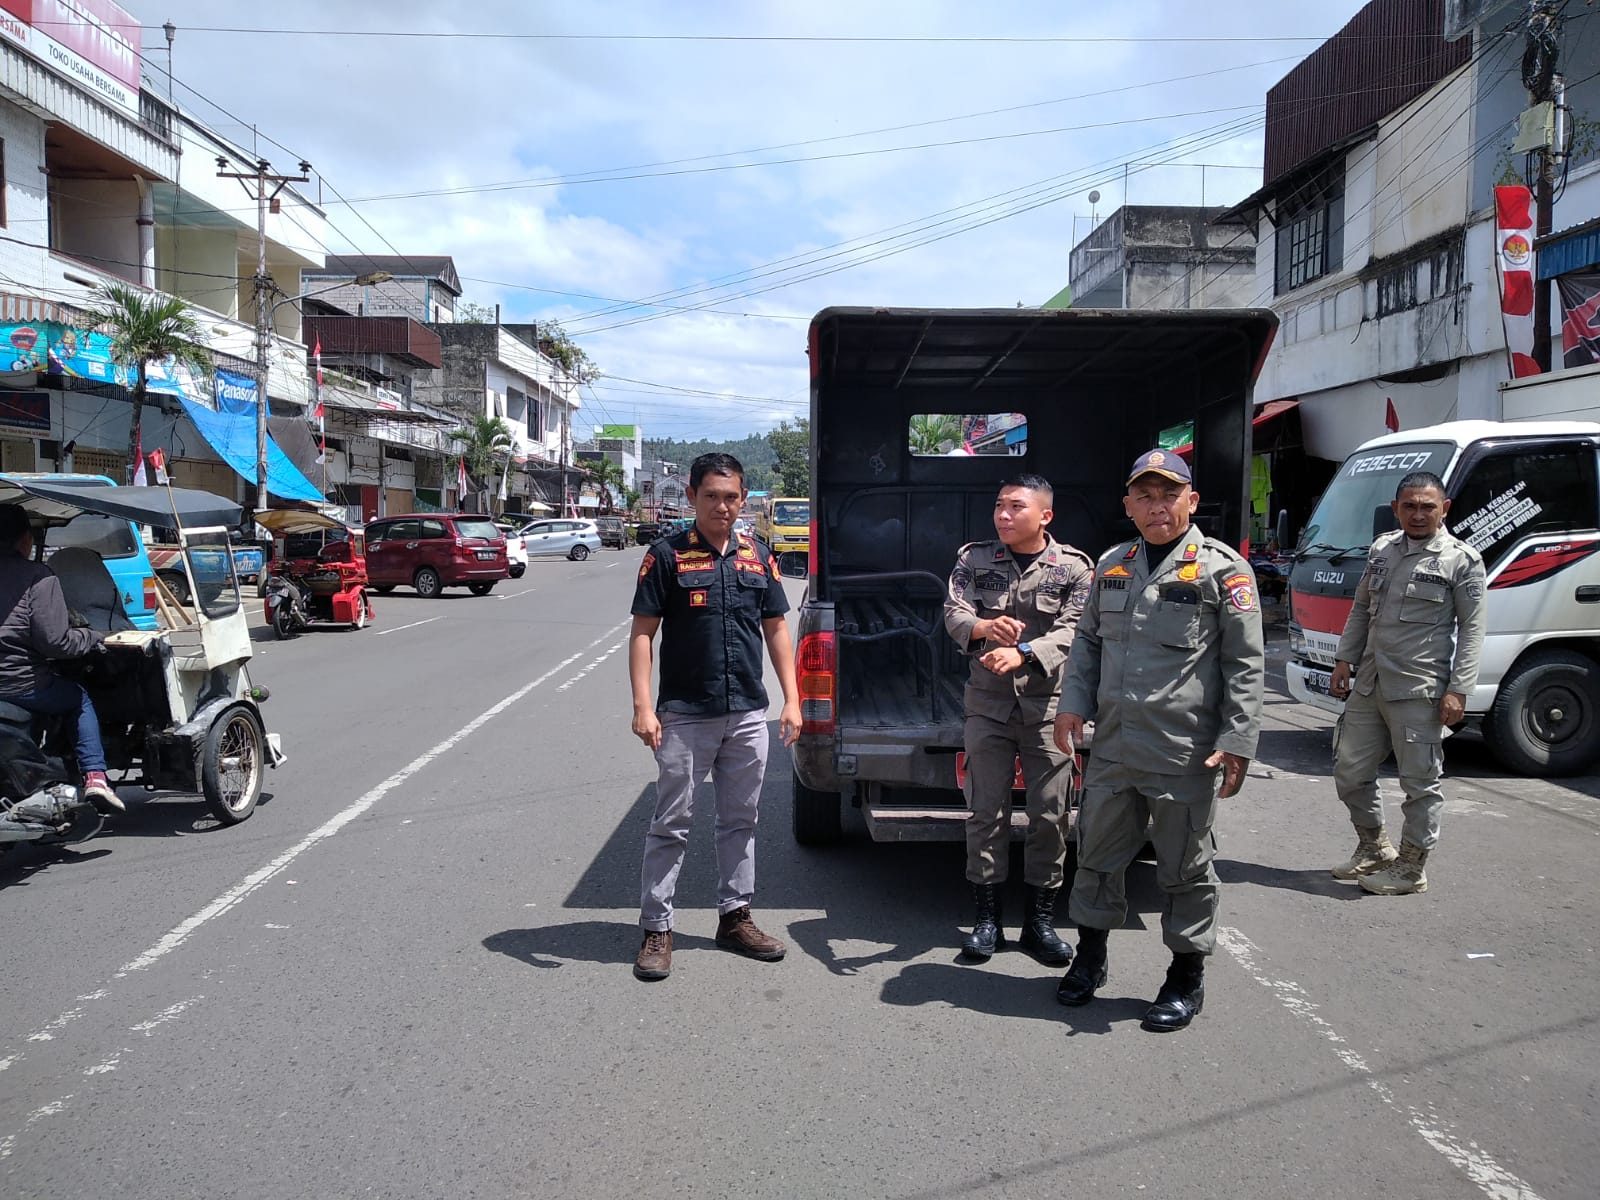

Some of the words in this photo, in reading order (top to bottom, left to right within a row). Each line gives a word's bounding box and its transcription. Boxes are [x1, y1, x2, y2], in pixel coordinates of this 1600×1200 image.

[42, 0, 134, 66] OLYTRON
[48, 44, 69, 66] TOKO
[70, 59, 95, 83] USAHA
[95, 75, 126, 104] BERSAMA
[1347, 451, 1433, 477] REBECCA
[1452, 507, 1489, 535] BEKERJA
[1486, 480, 1527, 511] KERASLAH
[1468, 528, 1488, 544] YANG
[1488, 519, 1502, 531] KAU
[1503, 499, 1530, 521] ANGGAP
[1470, 511, 1497, 533] SAMPAI
[1494, 496, 1519, 516] SEMUA
[1474, 535, 1497, 553] AHAL
[1496, 522, 1515, 540] JADI
[1512, 503, 1543, 528] MURAH
[1313, 570, 1345, 584] ISUZU
